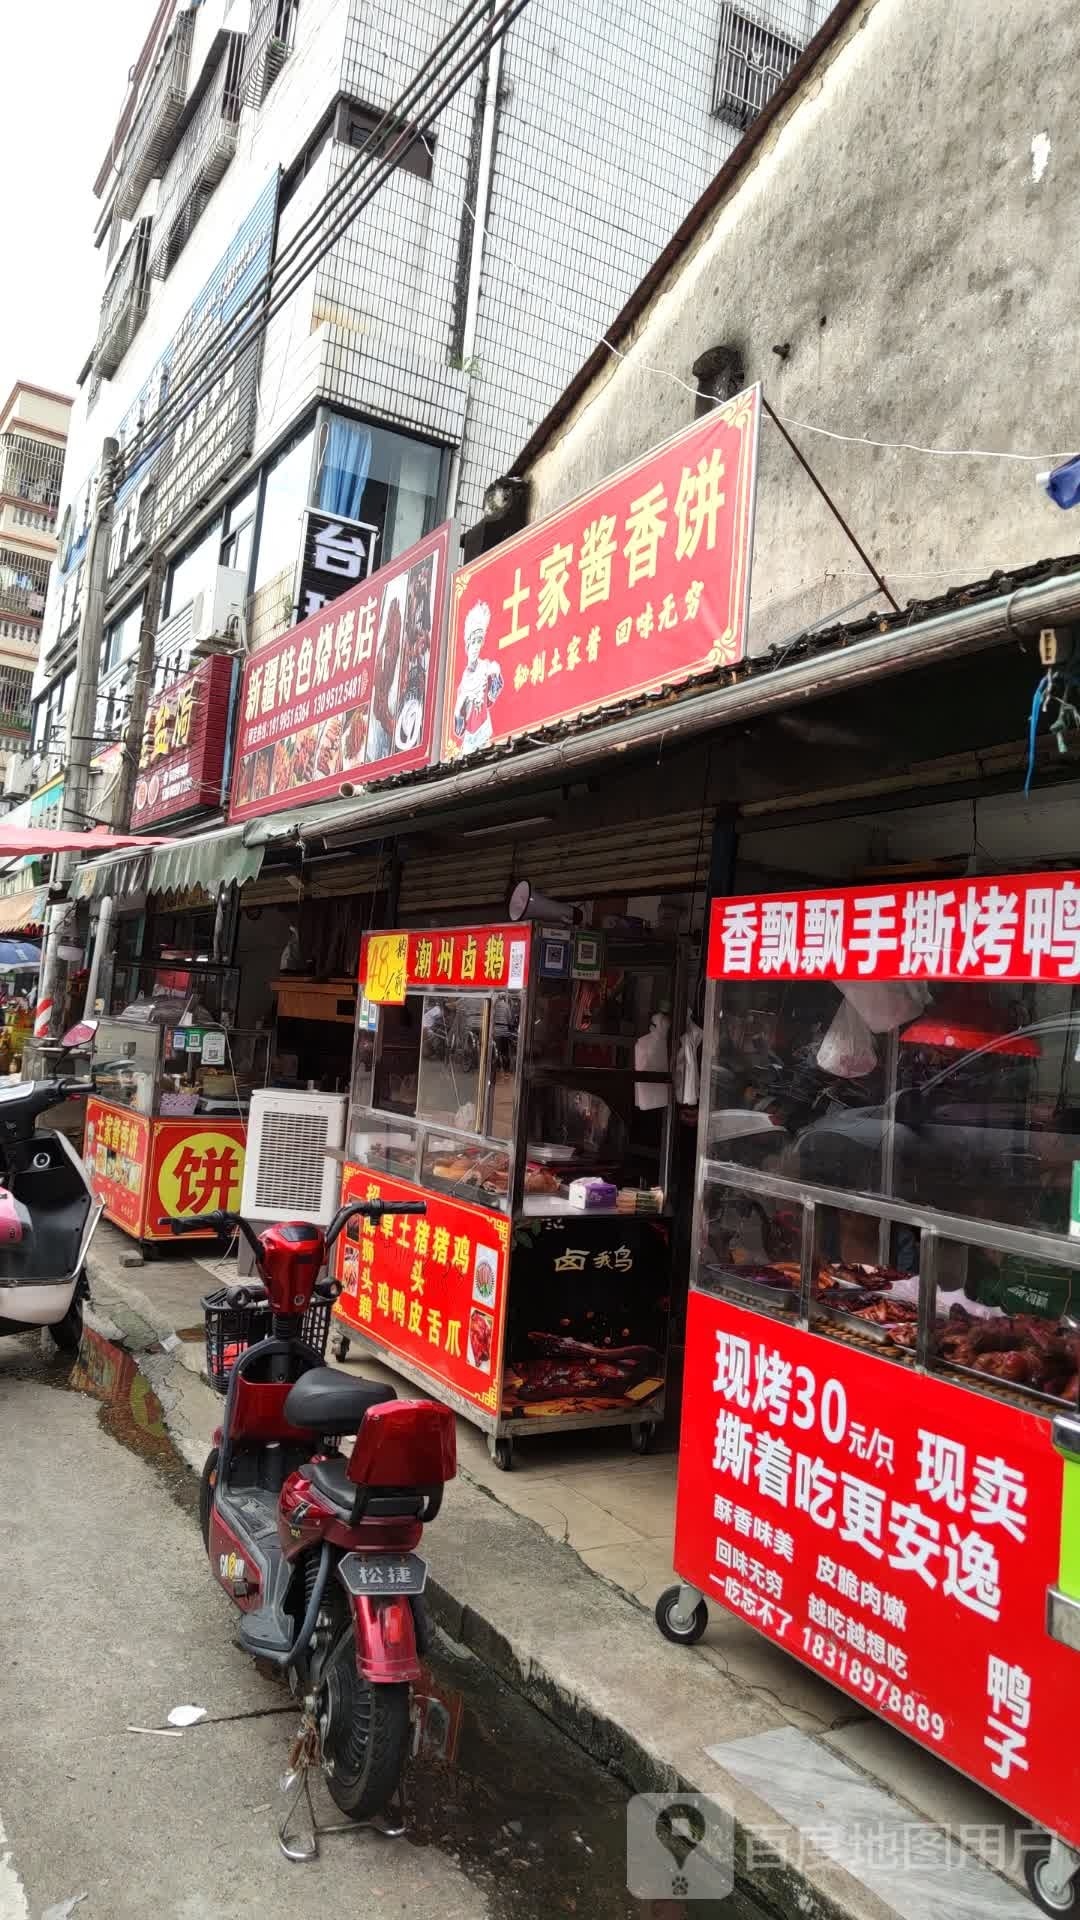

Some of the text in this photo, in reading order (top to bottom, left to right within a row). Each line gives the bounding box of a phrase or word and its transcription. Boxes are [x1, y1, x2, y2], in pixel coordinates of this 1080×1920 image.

[304, 522, 366, 617] 台
[498, 448, 726, 649] 土家酱香饼
[245, 596, 378, 723] 新疆特色烧烤店
[615, 580, 705, 647] 回味无穷
[414, 932, 505, 981] 潮州卤鹅
[720, 880, 1080, 978] 香飘飘手撕烤鸭
[96, 1112, 139, 1158] 土家酱香饼
[173, 1146, 240, 1214] 饼
[712, 1408, 1002, 1623] 撕着吃更安逸
[914, 1428, 1027, 1543] 现卖
[358, 1566, 413, 1585] 松捷
[712, 1494, 908, 1632] 酥香味美 皮脆肉嫩
[715, 1536, 909, 1681] 回味无穷 越吃越想吃
[708, 1572, 945, 1741] 一吃忘不了 18318978889
[983, 1654, 1032, 1781] 鸭子
